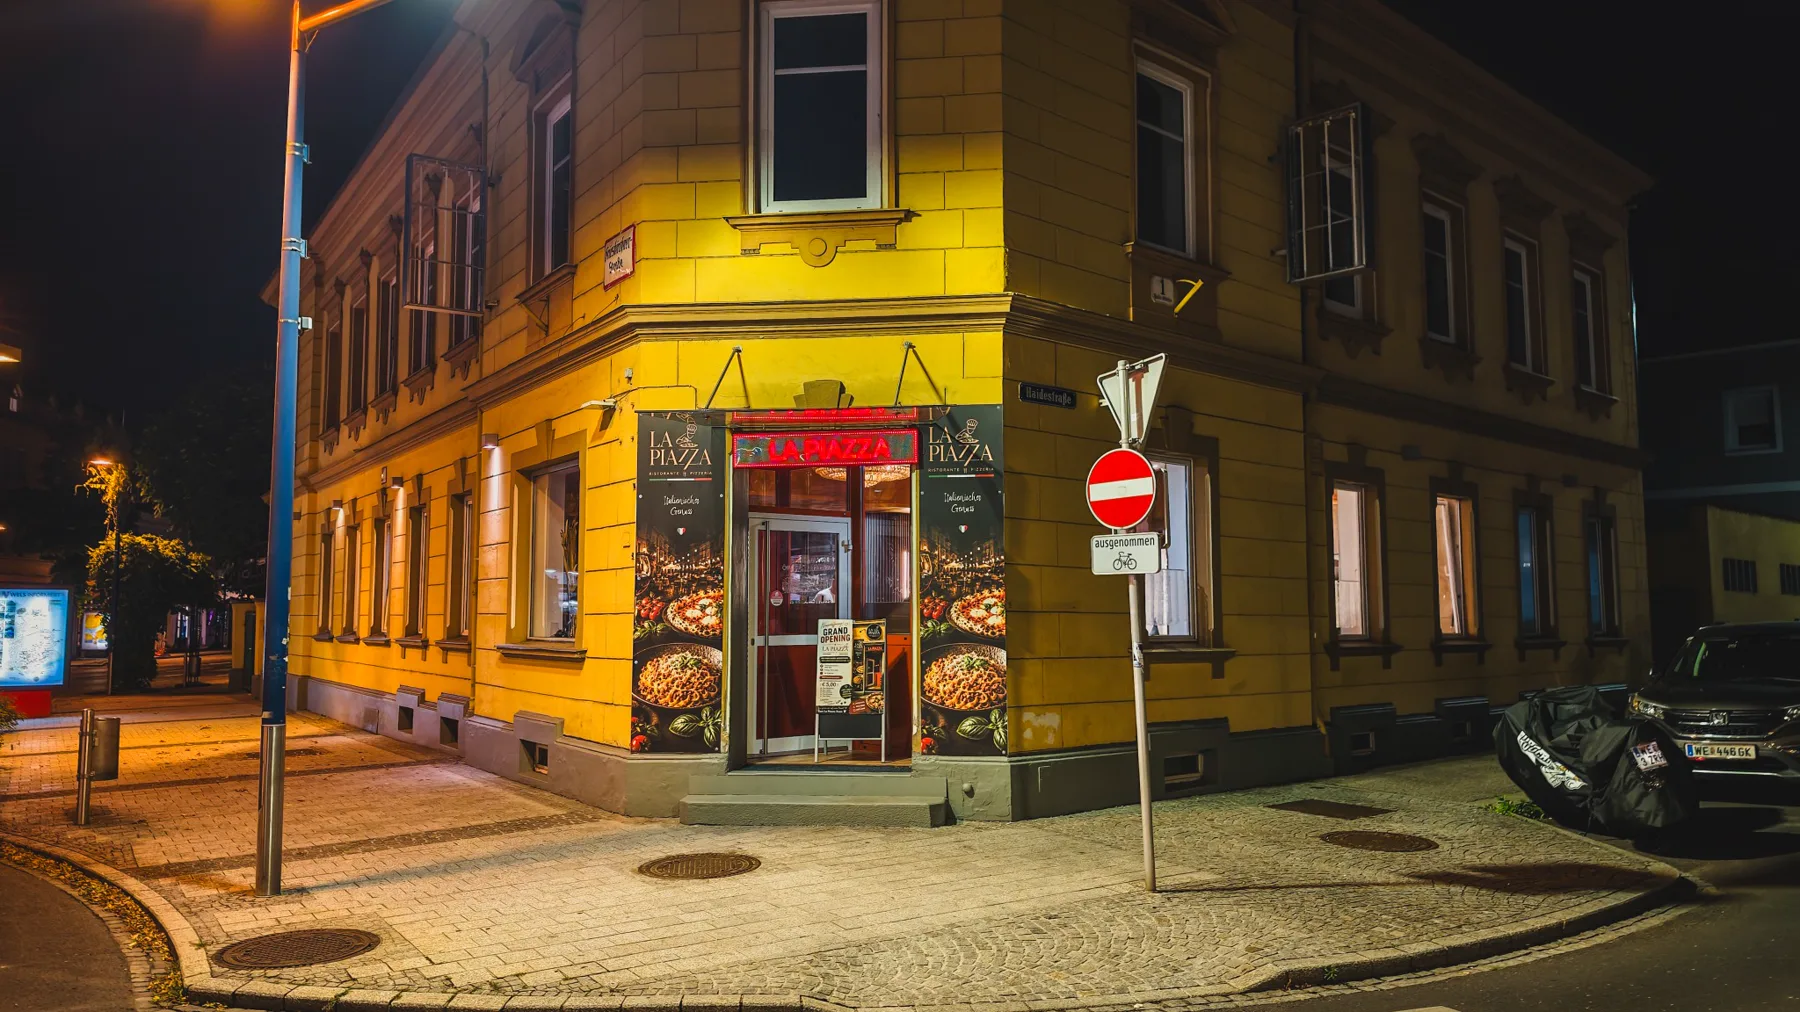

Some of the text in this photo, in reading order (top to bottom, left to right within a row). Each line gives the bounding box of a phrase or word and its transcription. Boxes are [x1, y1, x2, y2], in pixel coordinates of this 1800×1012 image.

[1026, 386, 1072, 405] Haidestraße
[650, 431, 673, 447] LA
[929, 427, 952, 443] LA
[768, 437, 891, 461] LA PIAZZA
[929, 444, 993, 466] PIAZZA
[650, 449, 712, 470] PIAZZA
[670, 507, 693, 516] Genuss
[951, 504, 975, 513] Genuss
[1095, 537, 1155, 549] ausgenommen
[823, 627, 848, 635] GRAND
[820, 635, 850, 643] OPENING
[1695, 747, 1708, 755] WE
[1641, 758, 1647, 766] 3
